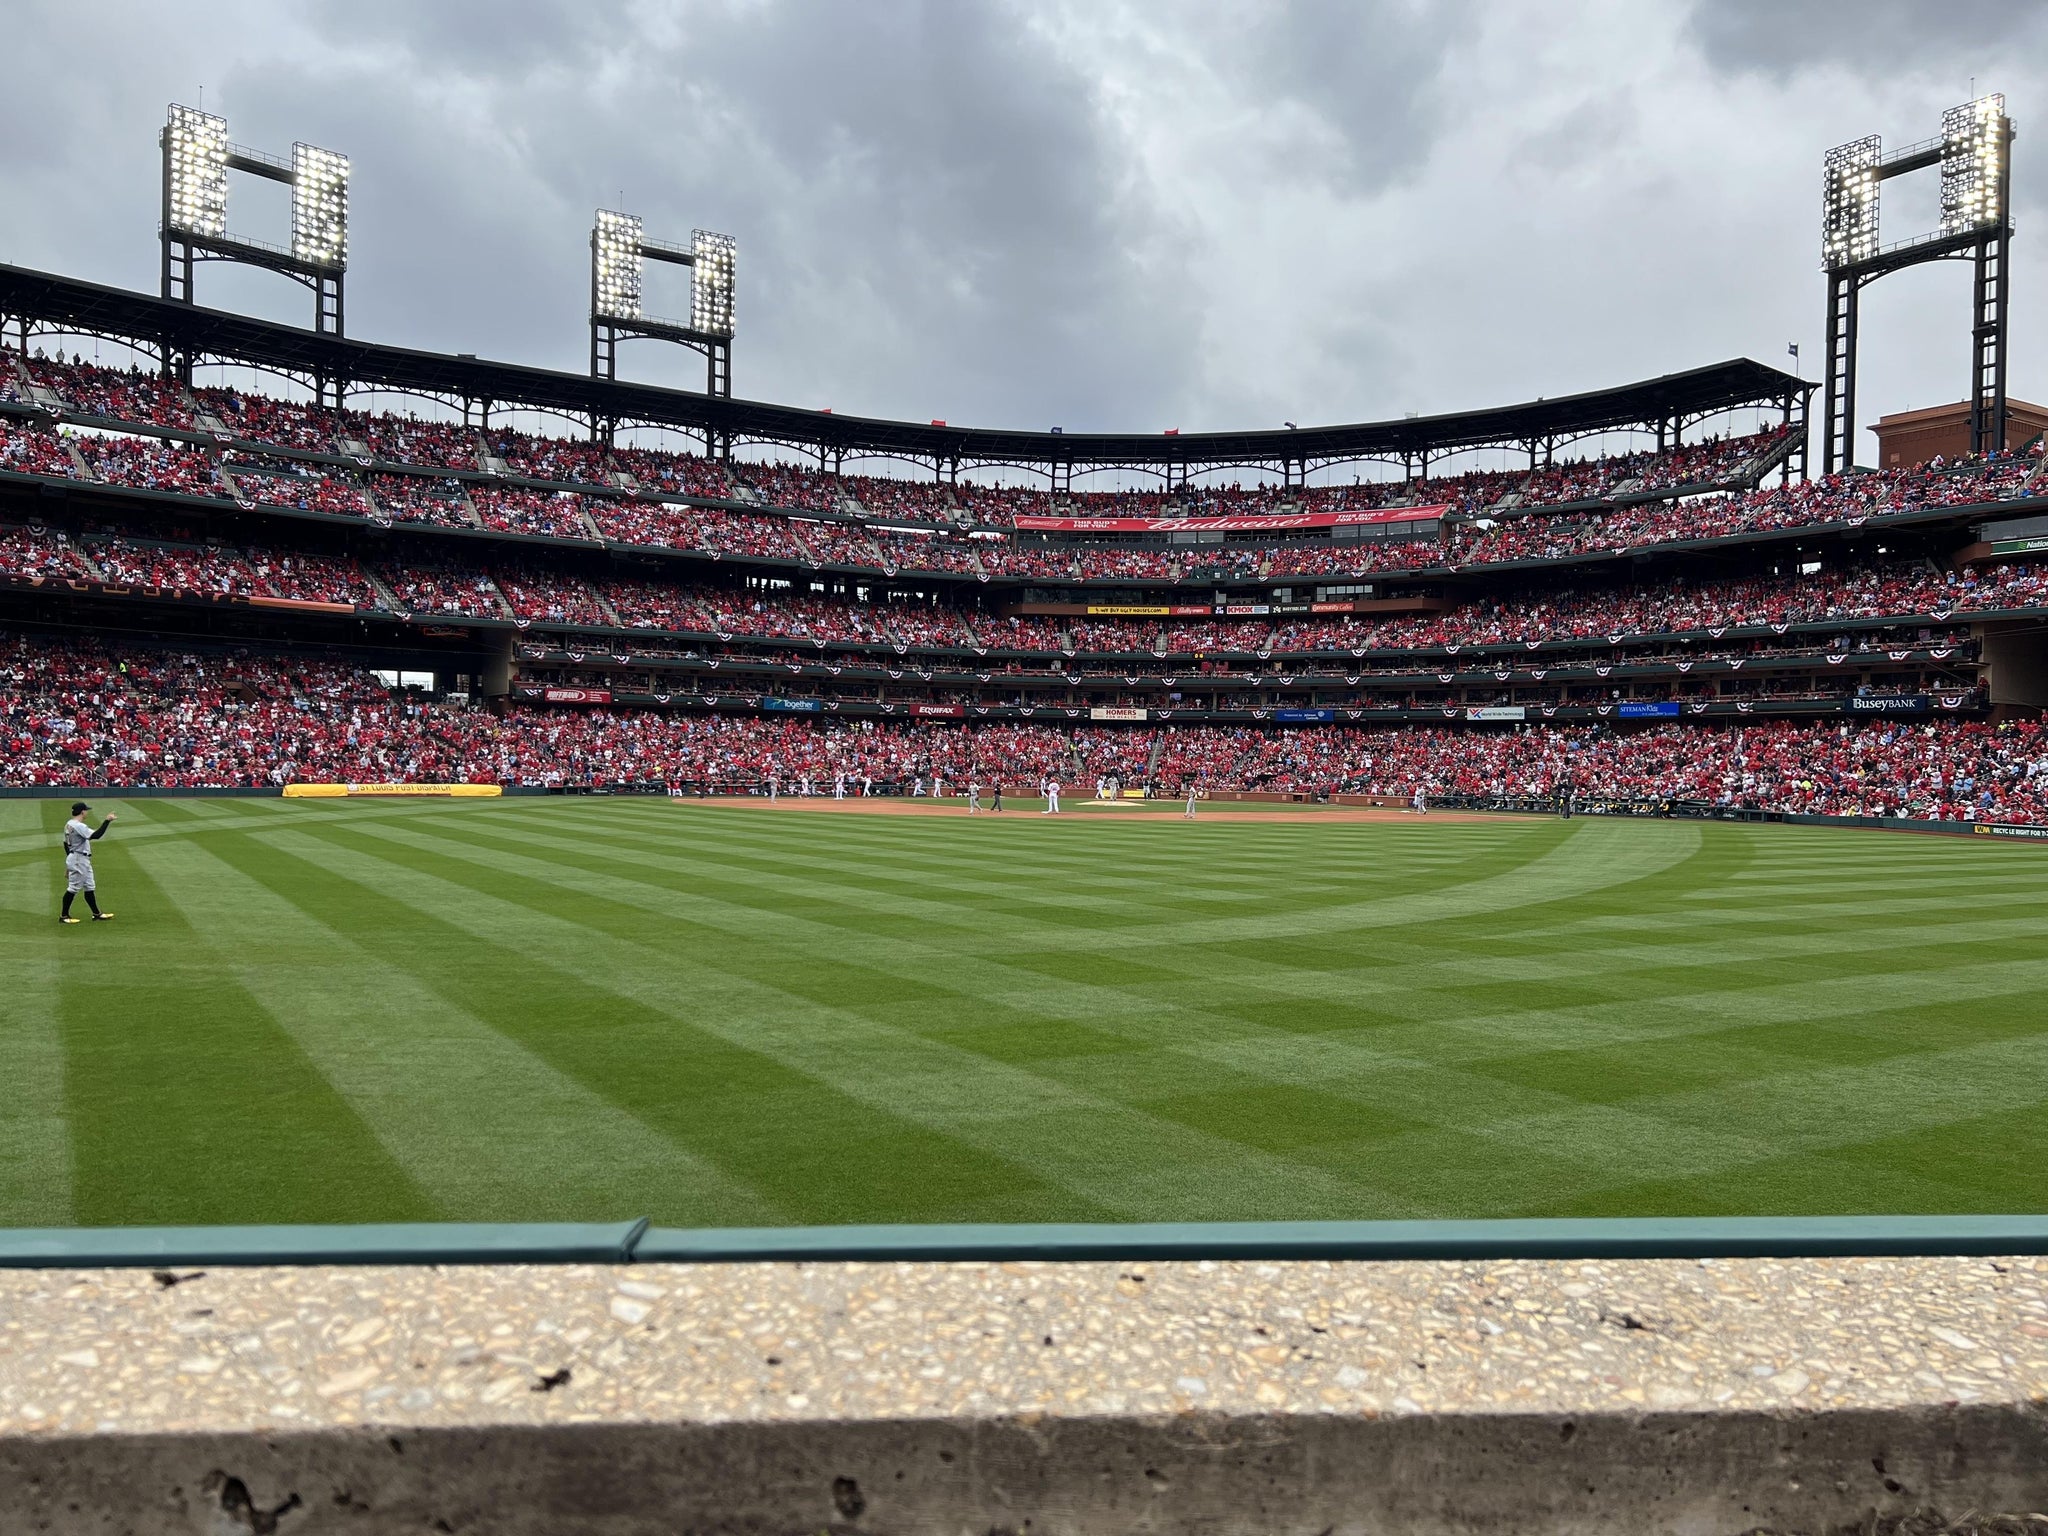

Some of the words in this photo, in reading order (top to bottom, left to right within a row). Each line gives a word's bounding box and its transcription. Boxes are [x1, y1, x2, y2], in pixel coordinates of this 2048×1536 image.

[1144, 517, 1312, 530] Budweiser
[784, 700, 813, 710] Together
[919, 706, 954, 715] EQUIFAX
